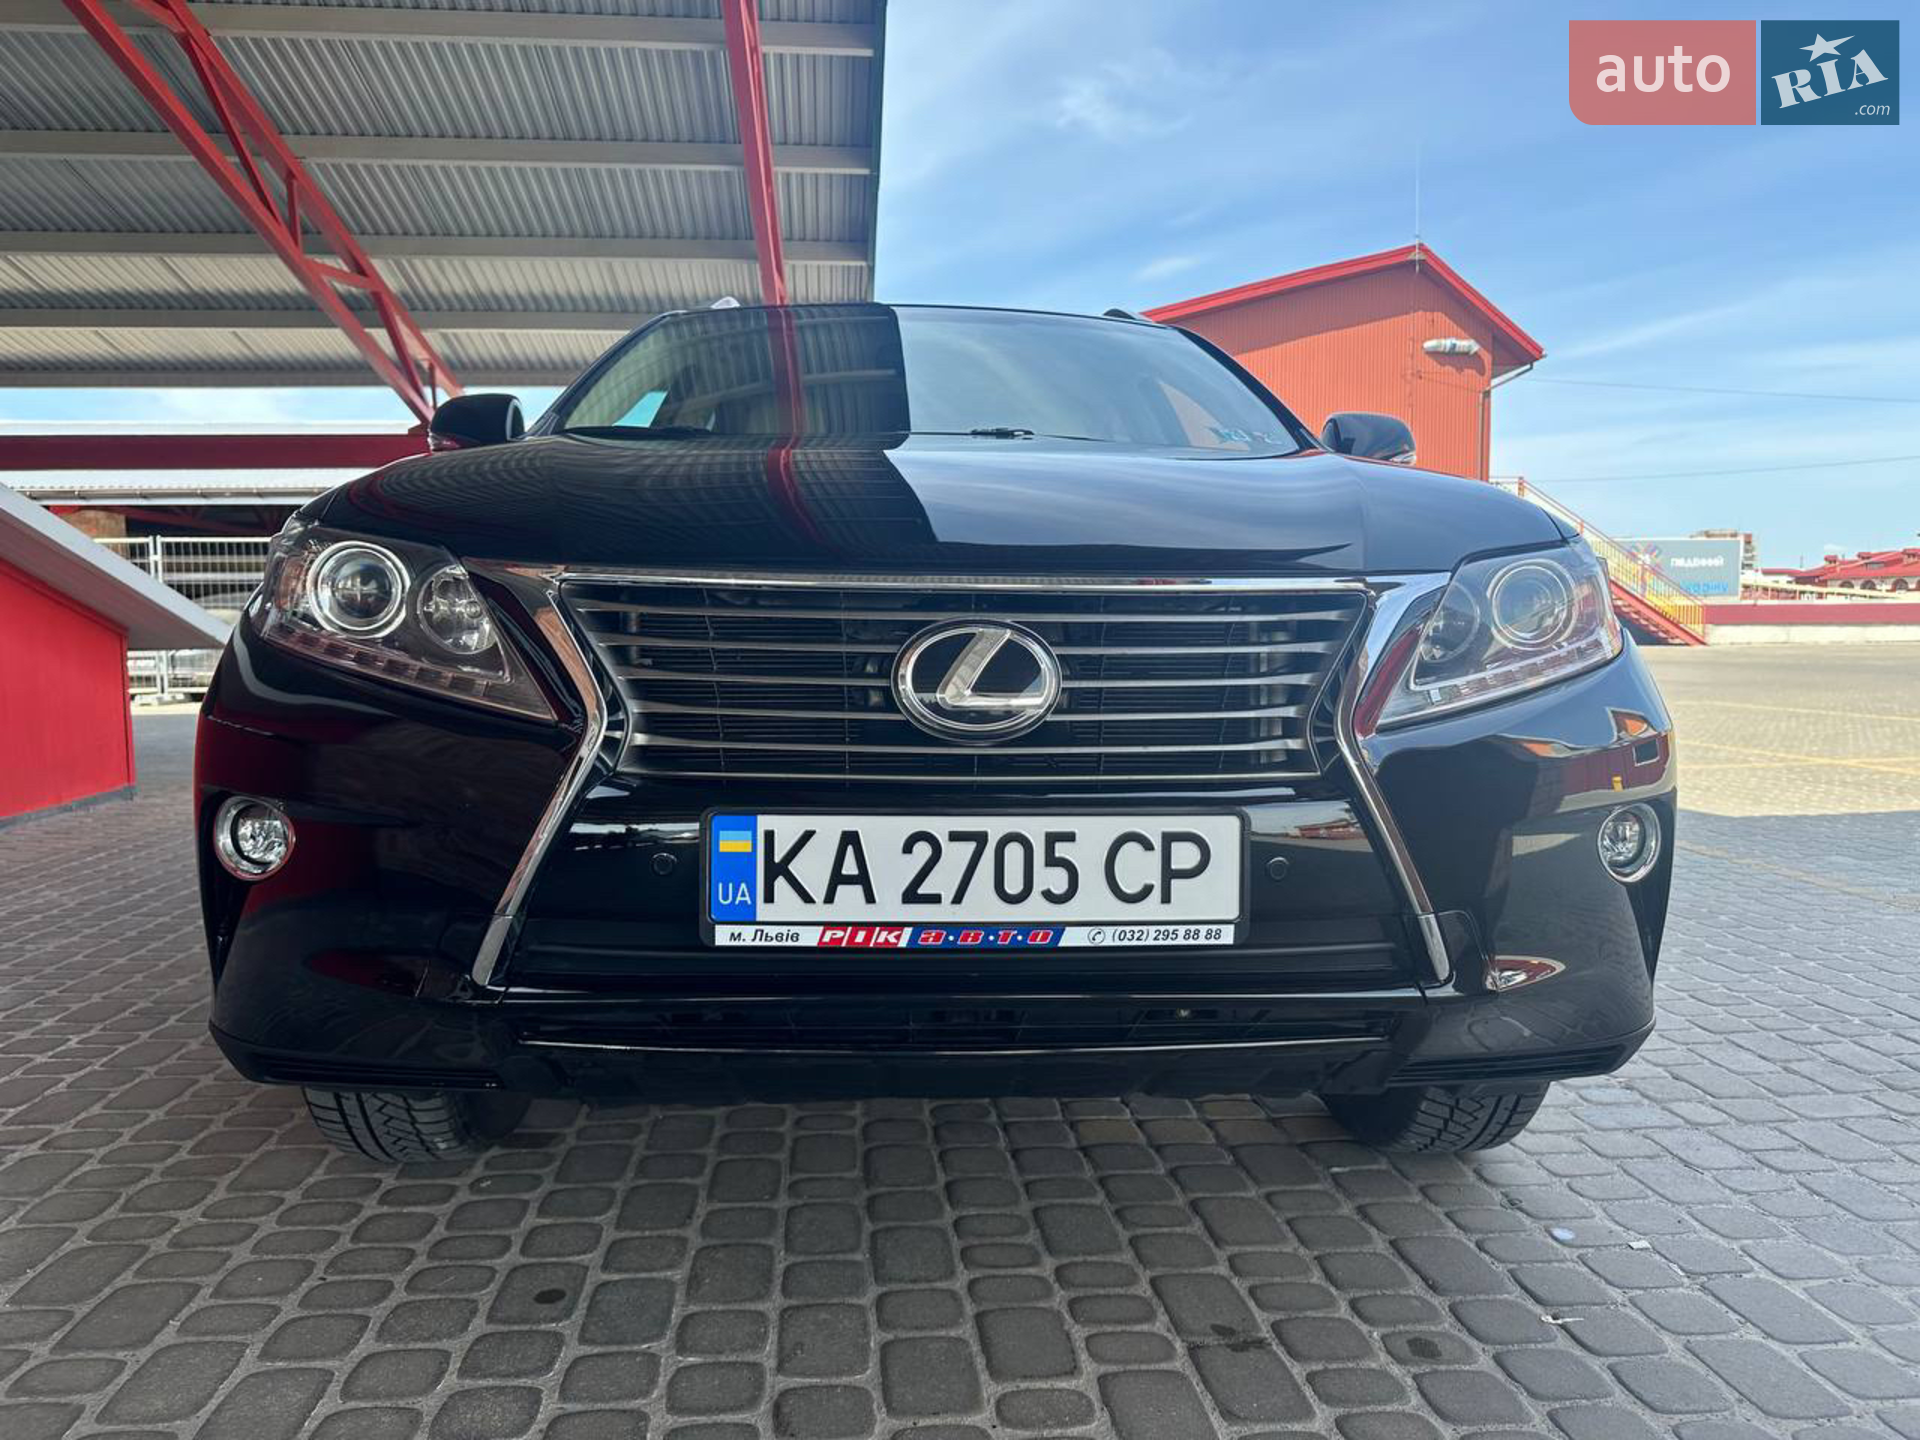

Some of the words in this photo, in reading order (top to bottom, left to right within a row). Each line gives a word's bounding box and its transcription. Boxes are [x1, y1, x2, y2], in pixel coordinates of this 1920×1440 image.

[763, 828, 877, 905] KA
[900, 830, 1080, 905] 2705
[1103, 830, 1212, 905] CP
[717, 881, 752, 906] UA
[750, 929, 801, 943] Львів
[1112, 928, 1150, 942] (032)
[1153, 928, 1179, 941] 295
[1182, 928, 1201, 941] 88
[1204, 928, 1222, 940] 88
